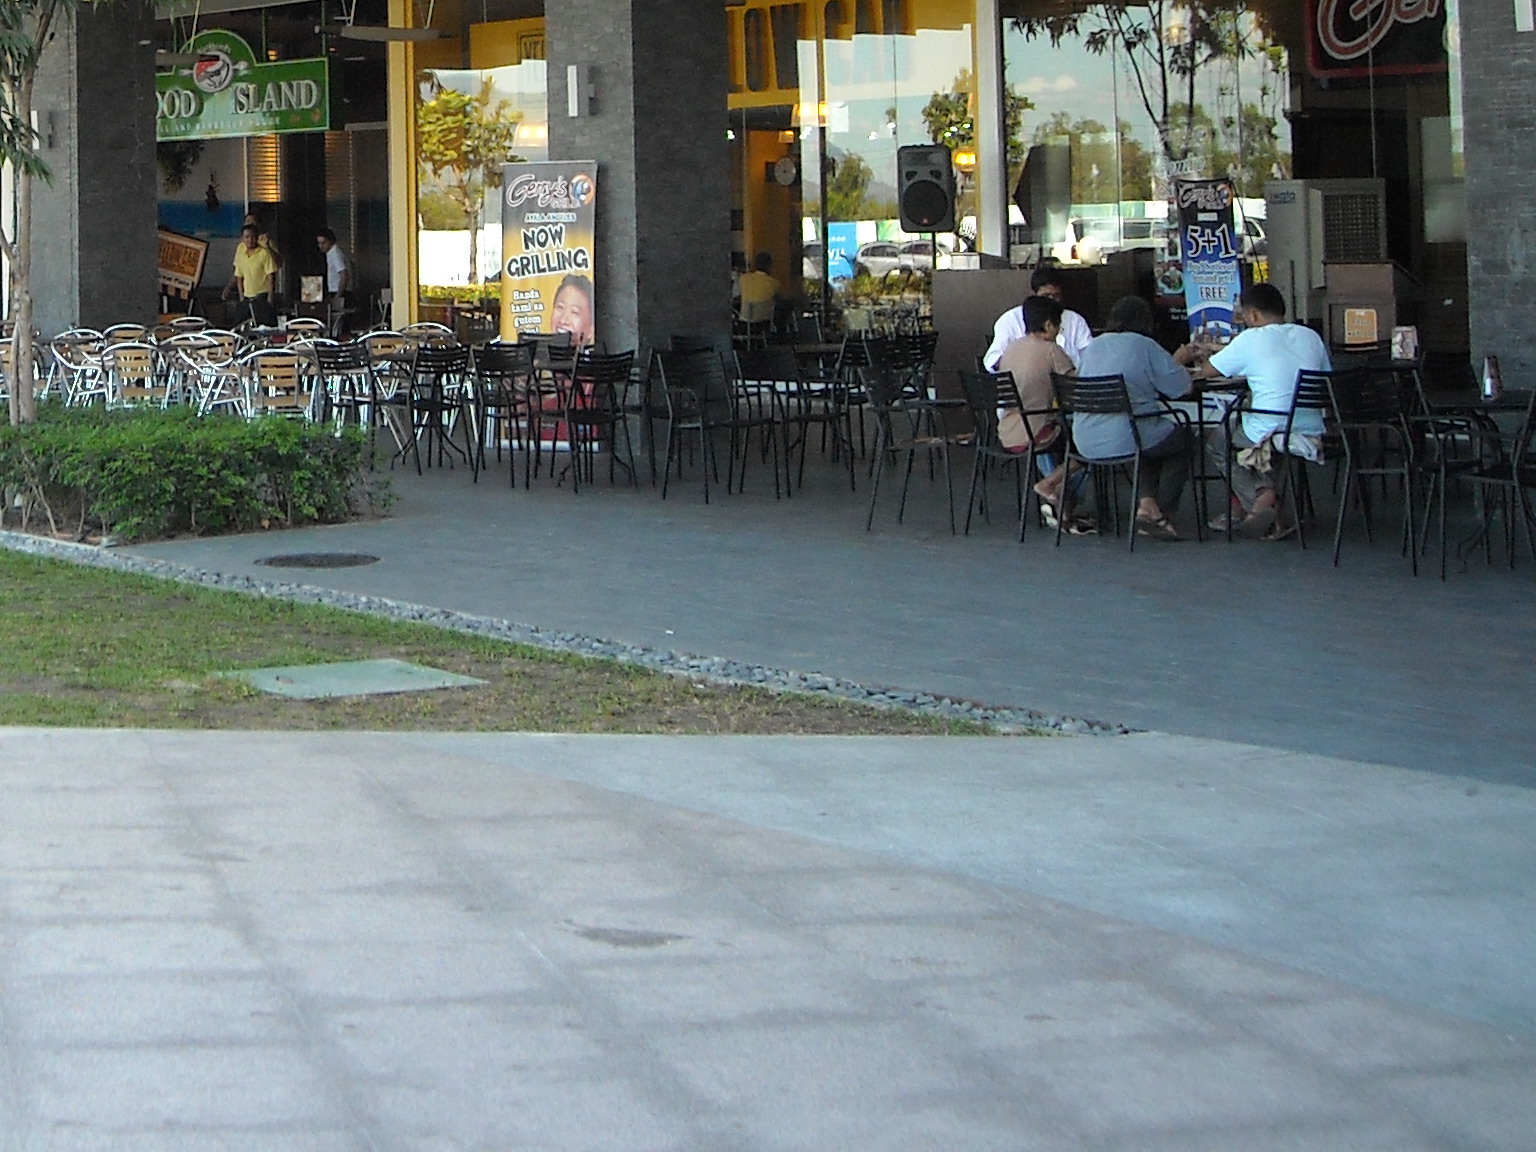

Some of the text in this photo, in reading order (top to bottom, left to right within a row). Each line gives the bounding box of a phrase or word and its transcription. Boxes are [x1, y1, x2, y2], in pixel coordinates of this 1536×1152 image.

[231, 79, 321, 115] ISLAND
[506, 173, 568, 208] Gerry's
[522, 224, 565, 252] NOW
[1187, 223, 1237, 259] 5+1
[506, 248, 590, 279] GRILLING
